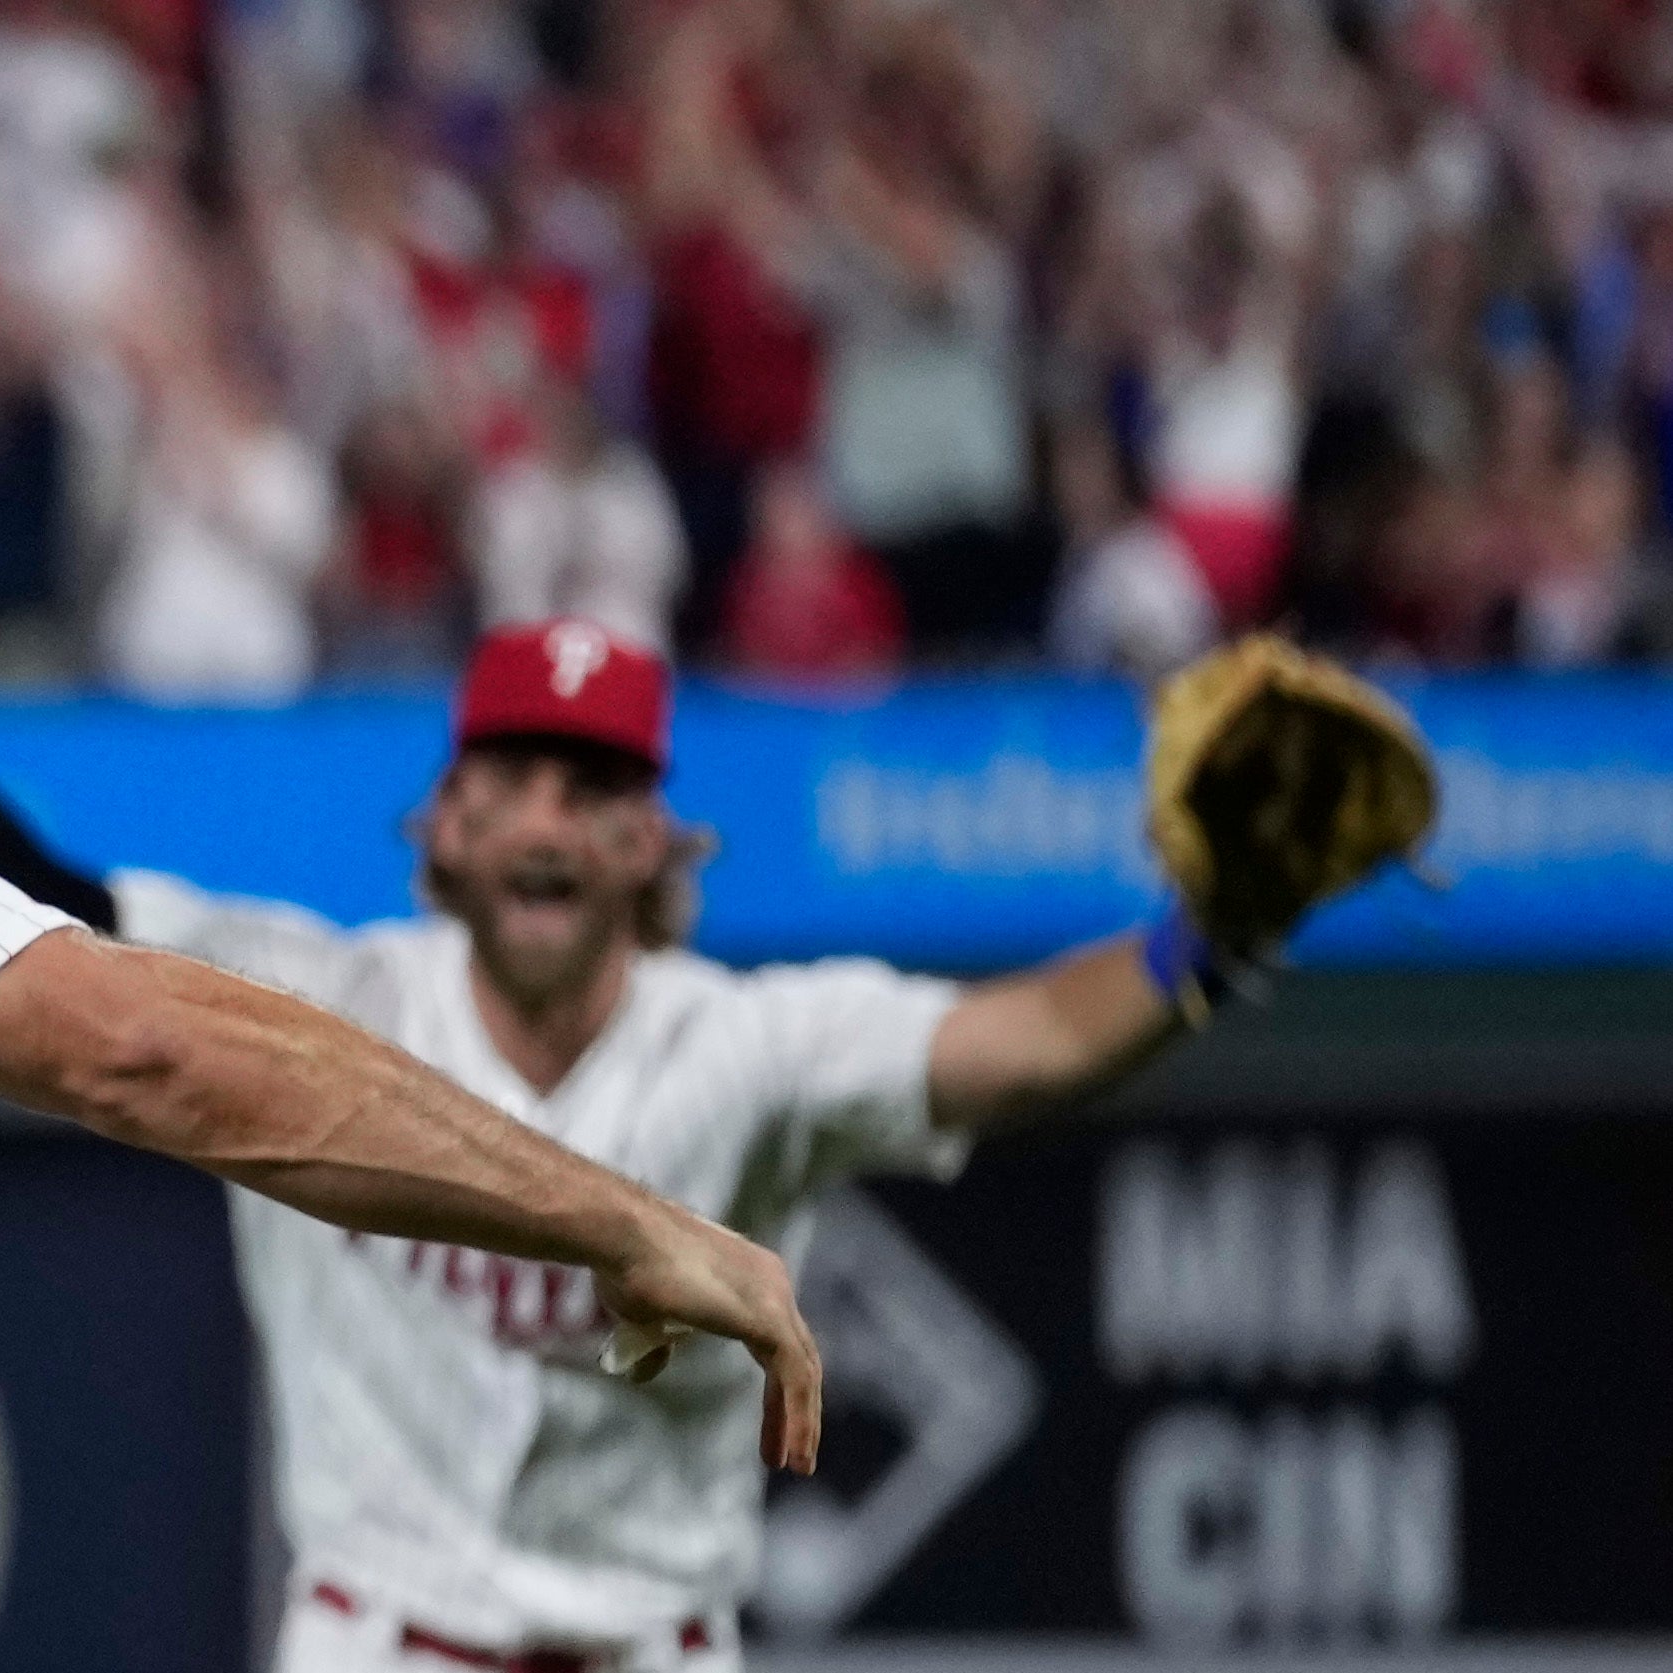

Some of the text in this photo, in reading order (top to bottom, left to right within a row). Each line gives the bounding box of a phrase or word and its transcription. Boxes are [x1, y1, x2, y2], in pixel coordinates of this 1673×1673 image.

[543, 620, 609, 700] P
[1101, 1145, 1473, 1380] MIA
[1119, 1406, 1461, 1640] CIN
